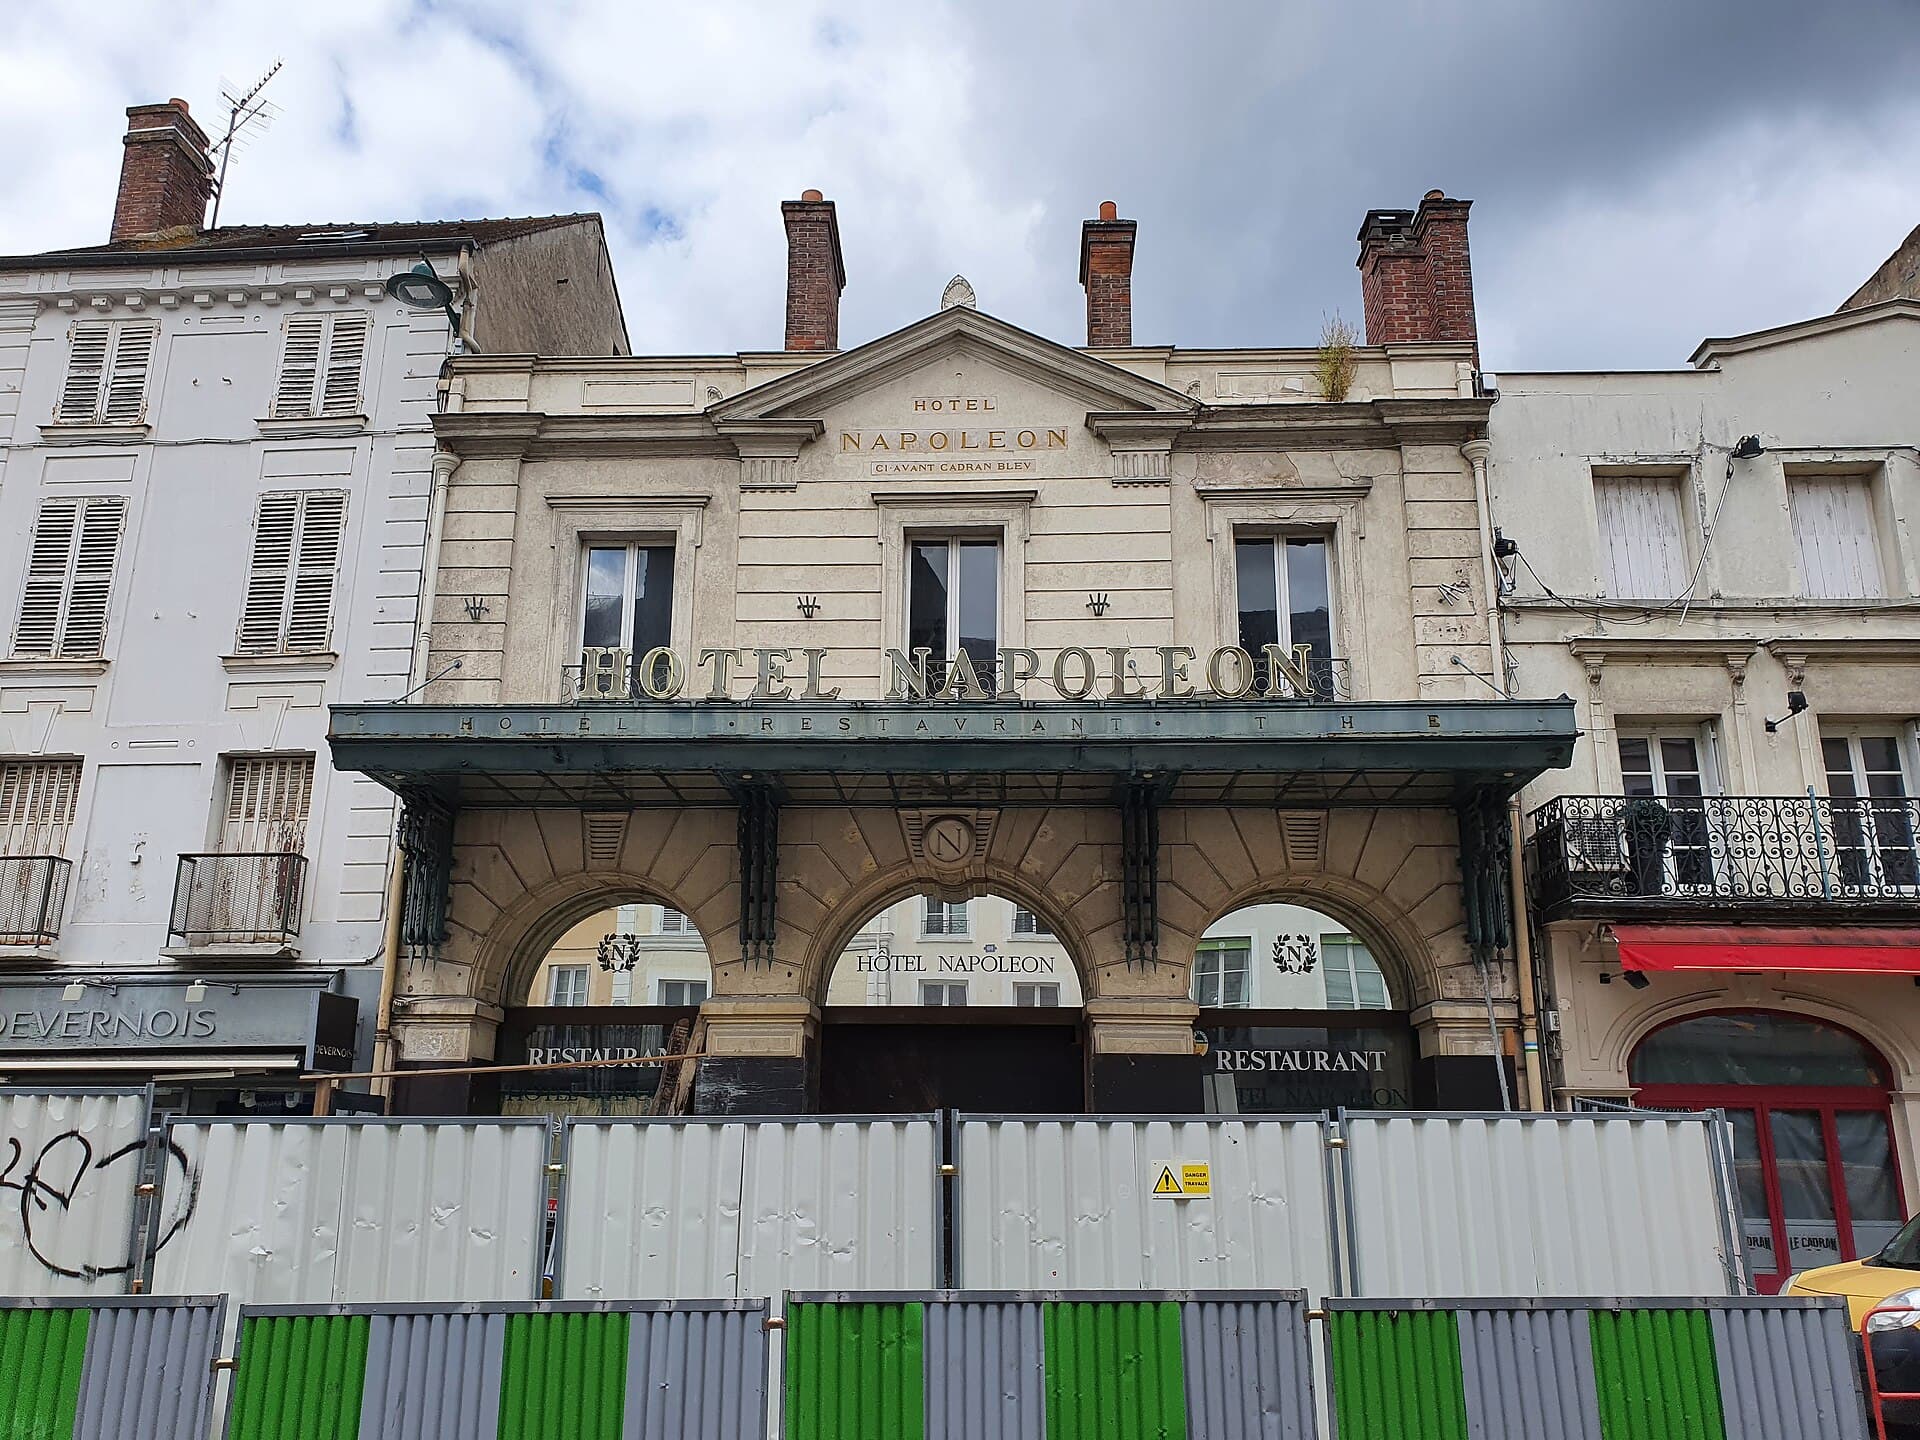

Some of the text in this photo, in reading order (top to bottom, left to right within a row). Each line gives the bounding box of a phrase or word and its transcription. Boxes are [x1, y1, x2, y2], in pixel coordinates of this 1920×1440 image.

[913, 399, 995, 411] HOTEL
[841, 429, 1068, 450] NAPOLEON
[940, 462, 992, 472] CADRAN
[997, 462, 1032, 471] BLEV
[578, 643, 1316, 700] HOTEL NAPOLEON
[459, 717, 628, 731] HOTEL
[935, 827, 962, 856] N
[609, 944, 627, 962] N
[857, 950, 1055, 974] HÔTEL NAPOLEON
[1286, 945, 1302, 963] N
[0, 1008, 216, 1038] EVERNOIS
[528, 1047, 668, 1068] RESTAURA
[1215, 1050, 1386, 1071] RESTAURANT
[1790, 1237, 1800, 1250] LE
[1801, 1237, 1837, 1251] CADRAN
